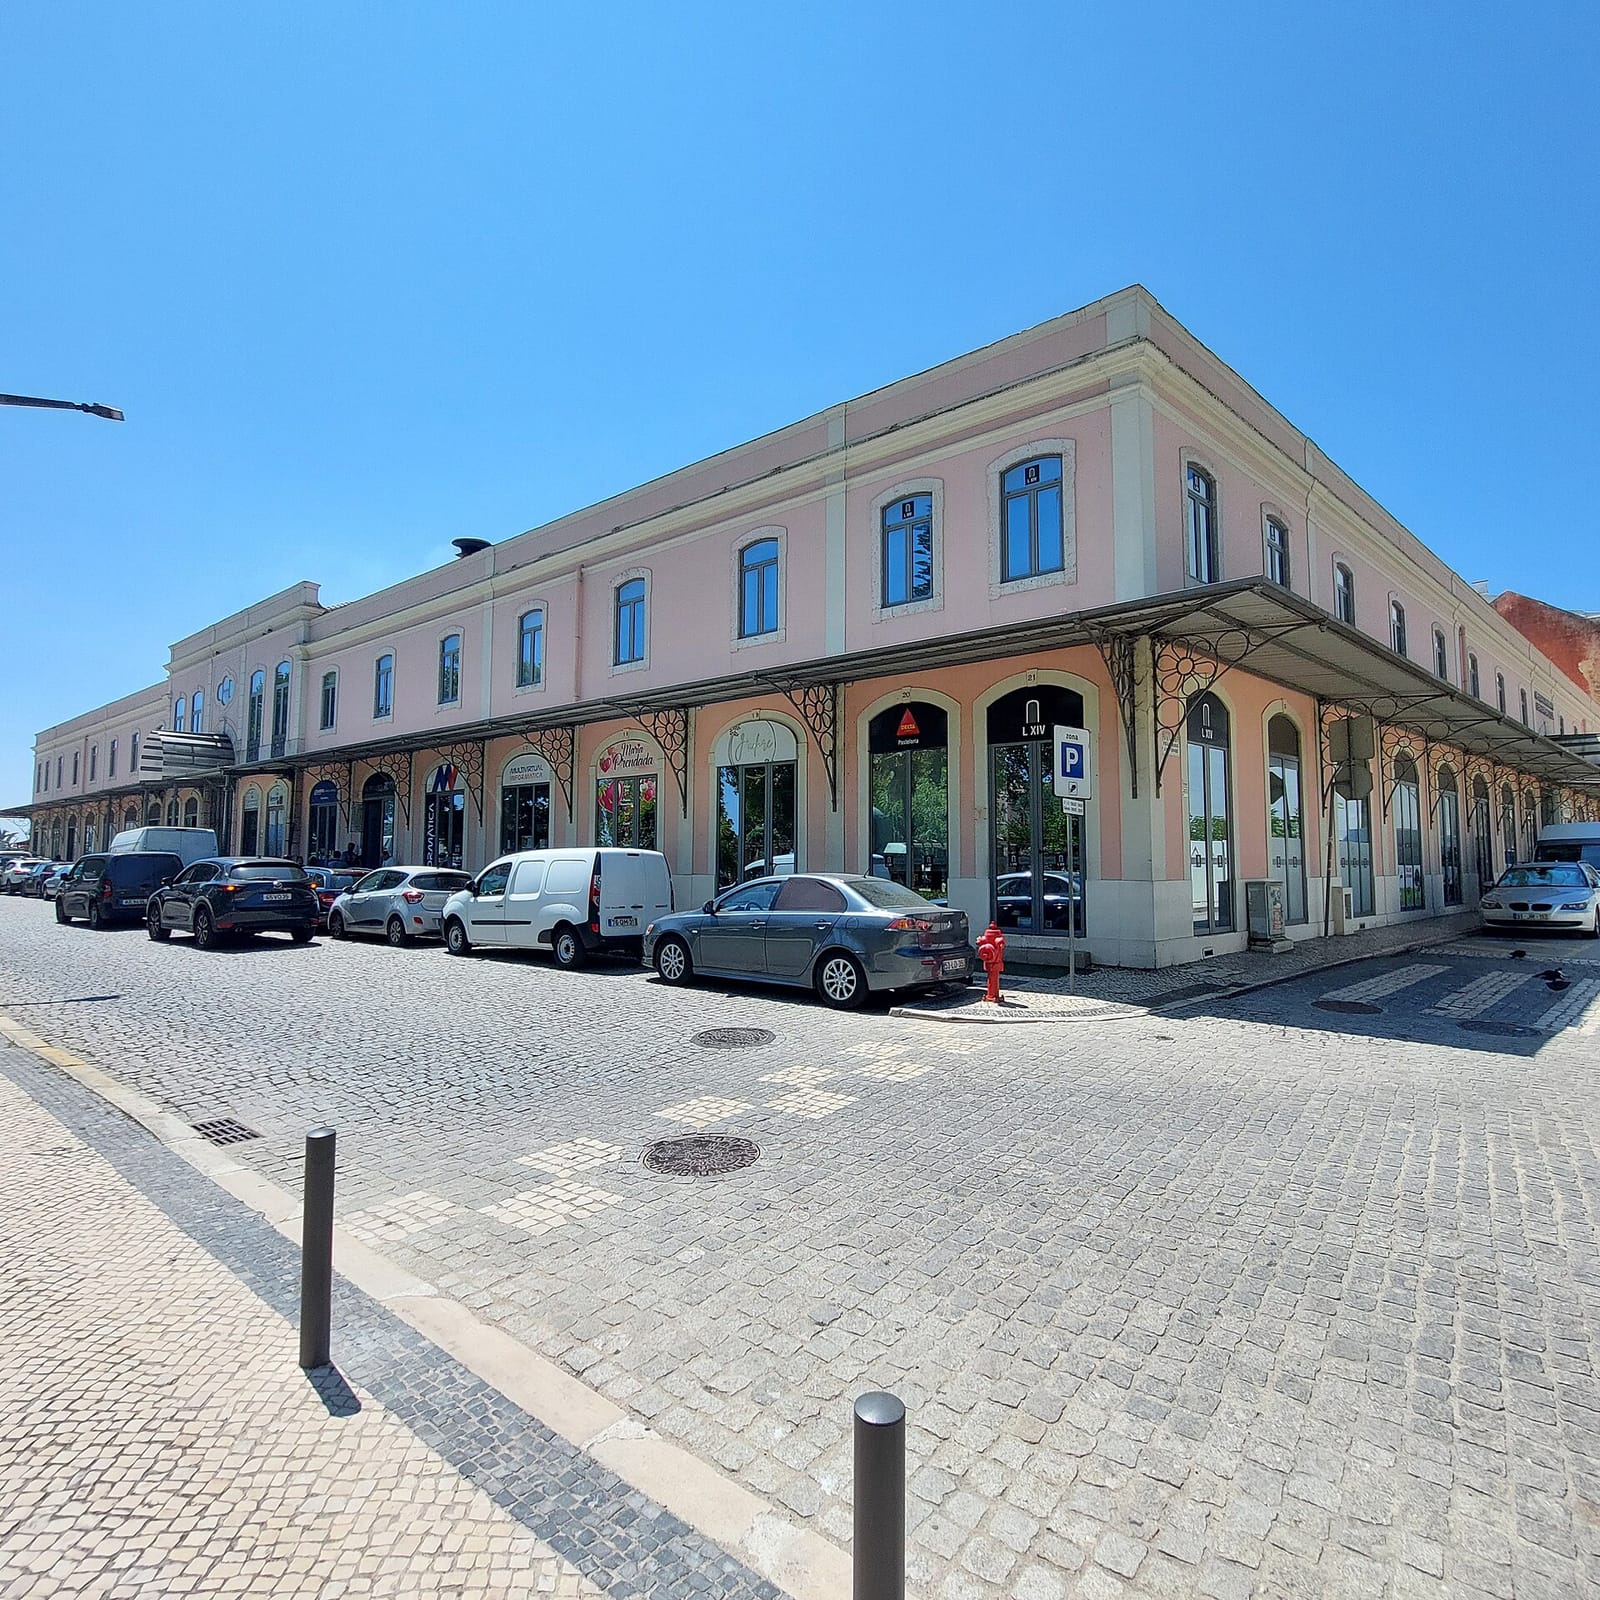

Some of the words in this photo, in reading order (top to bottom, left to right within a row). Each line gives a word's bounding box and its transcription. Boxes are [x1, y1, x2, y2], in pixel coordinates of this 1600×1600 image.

[1022, 726, 1028, 736] L
[1030, 724, 1046, 736] XIV
[1065, 733, 1079, 741] zona
[621, 743, 643, 757] Maria
[1066, 747, 1079, 773] P
[425, 803, 435, 867] ORMATICA
